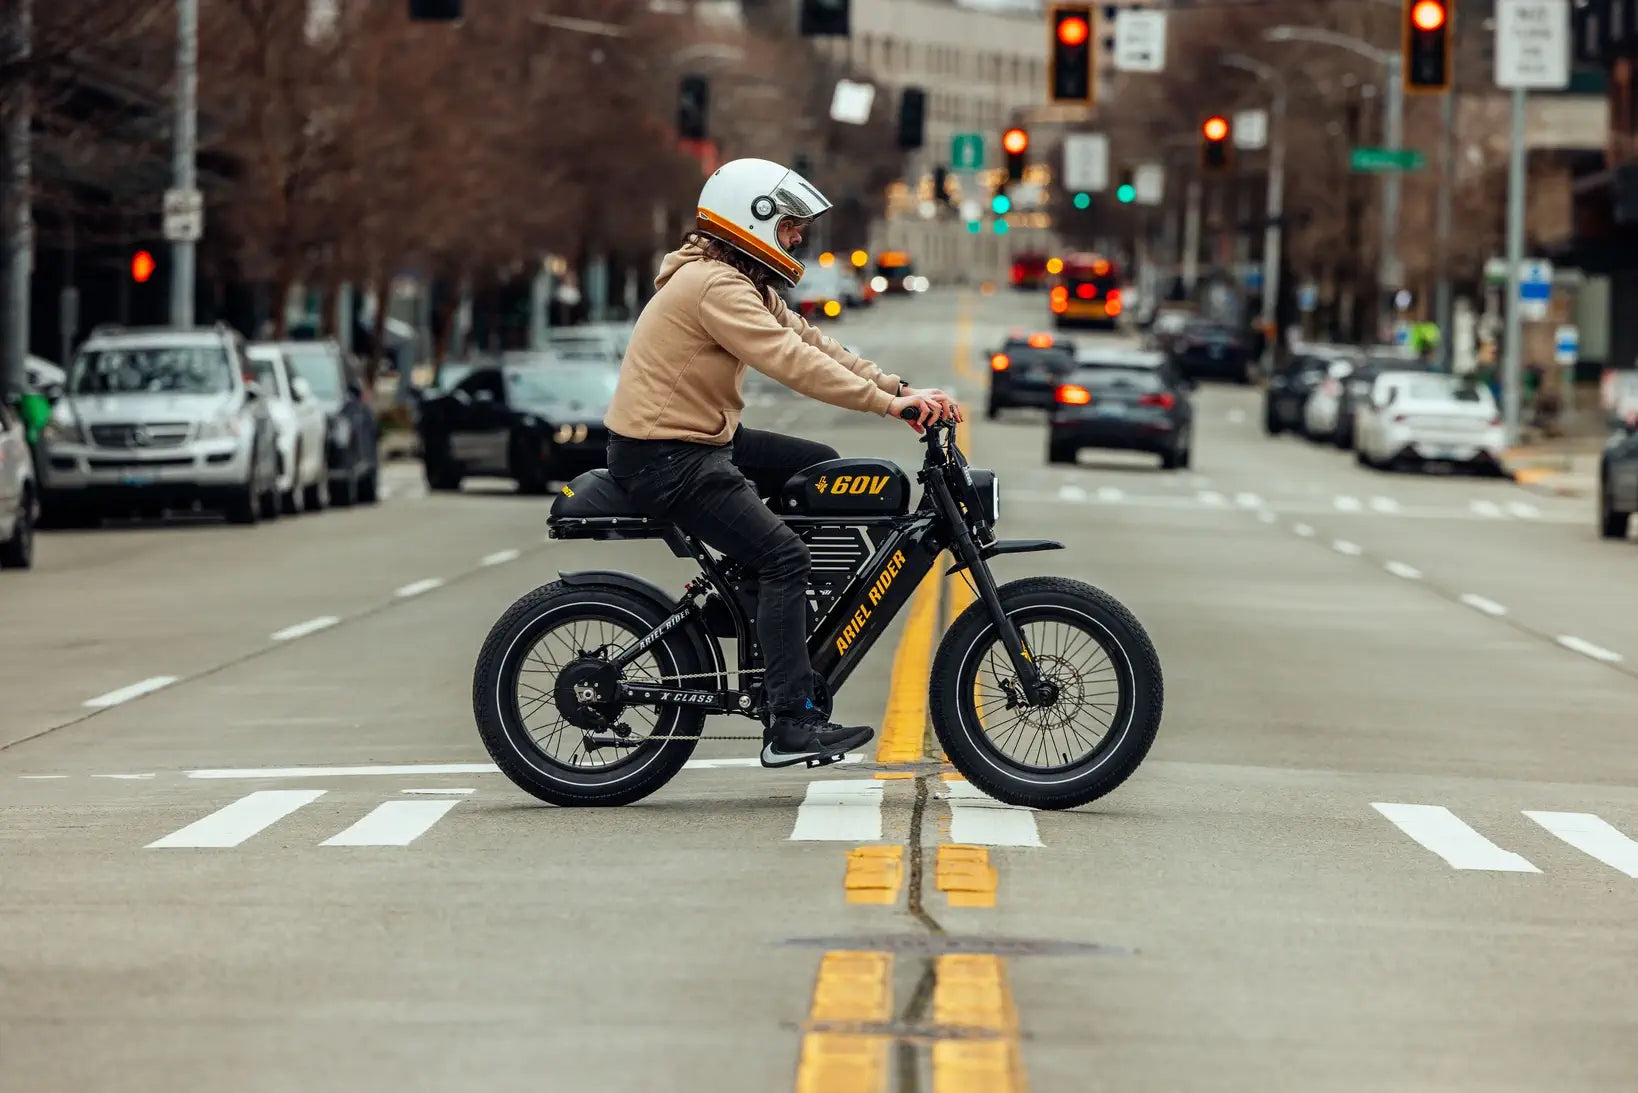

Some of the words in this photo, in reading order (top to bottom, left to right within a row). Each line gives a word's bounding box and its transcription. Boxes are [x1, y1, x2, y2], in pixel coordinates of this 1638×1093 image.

[830, 475, 891, 495] 60V
[836, 603, 872, 656] ARIEL
[868, 549, 906, 607] RIDER
[640, 628, 664, 650] ARIEL
[665, 608, 690, 630] RIDER
[660, 692, 671, 701] X
[673, 693, 714, 703] CLASS
